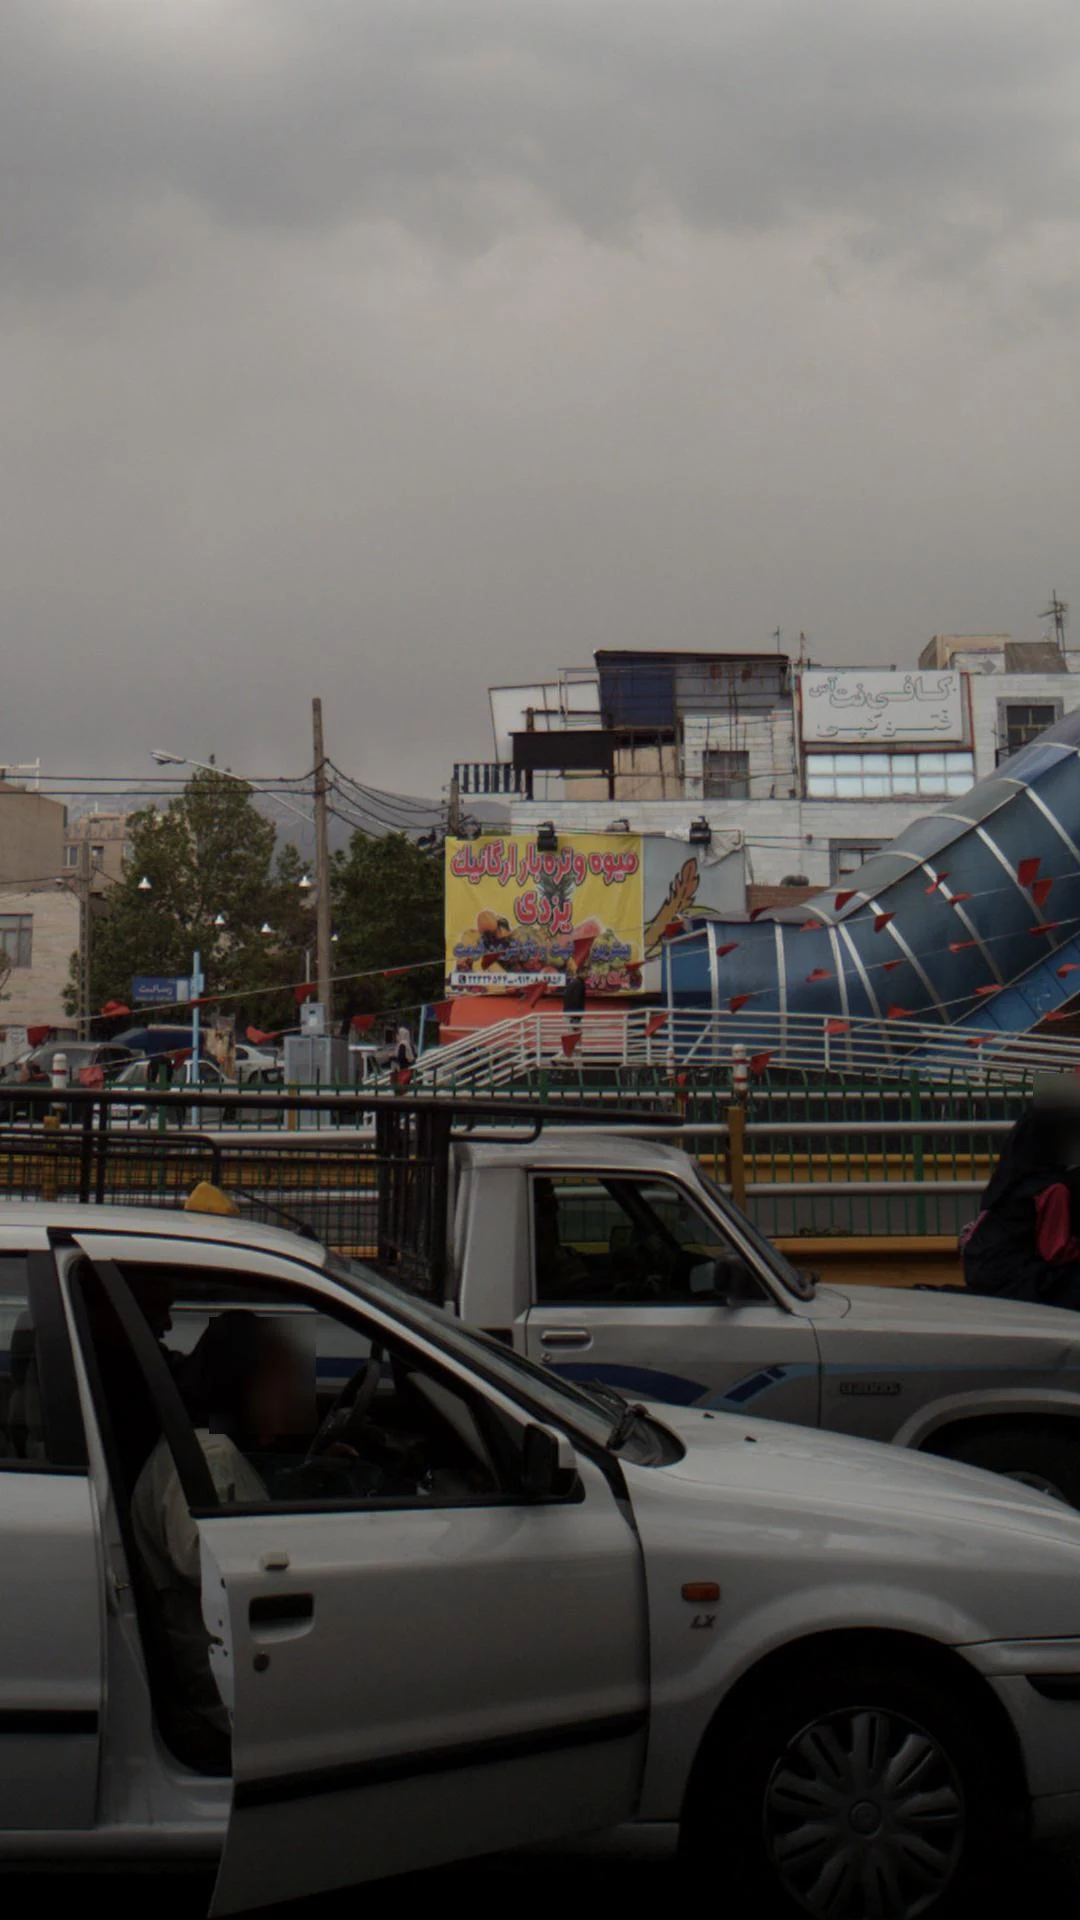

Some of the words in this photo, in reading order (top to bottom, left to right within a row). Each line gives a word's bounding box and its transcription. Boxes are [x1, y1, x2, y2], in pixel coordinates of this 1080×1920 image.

[589, 850, 639, 886] میوه
[513, 890, 573, 935] یزدی
[689, 1615, 717, 1629] LX
